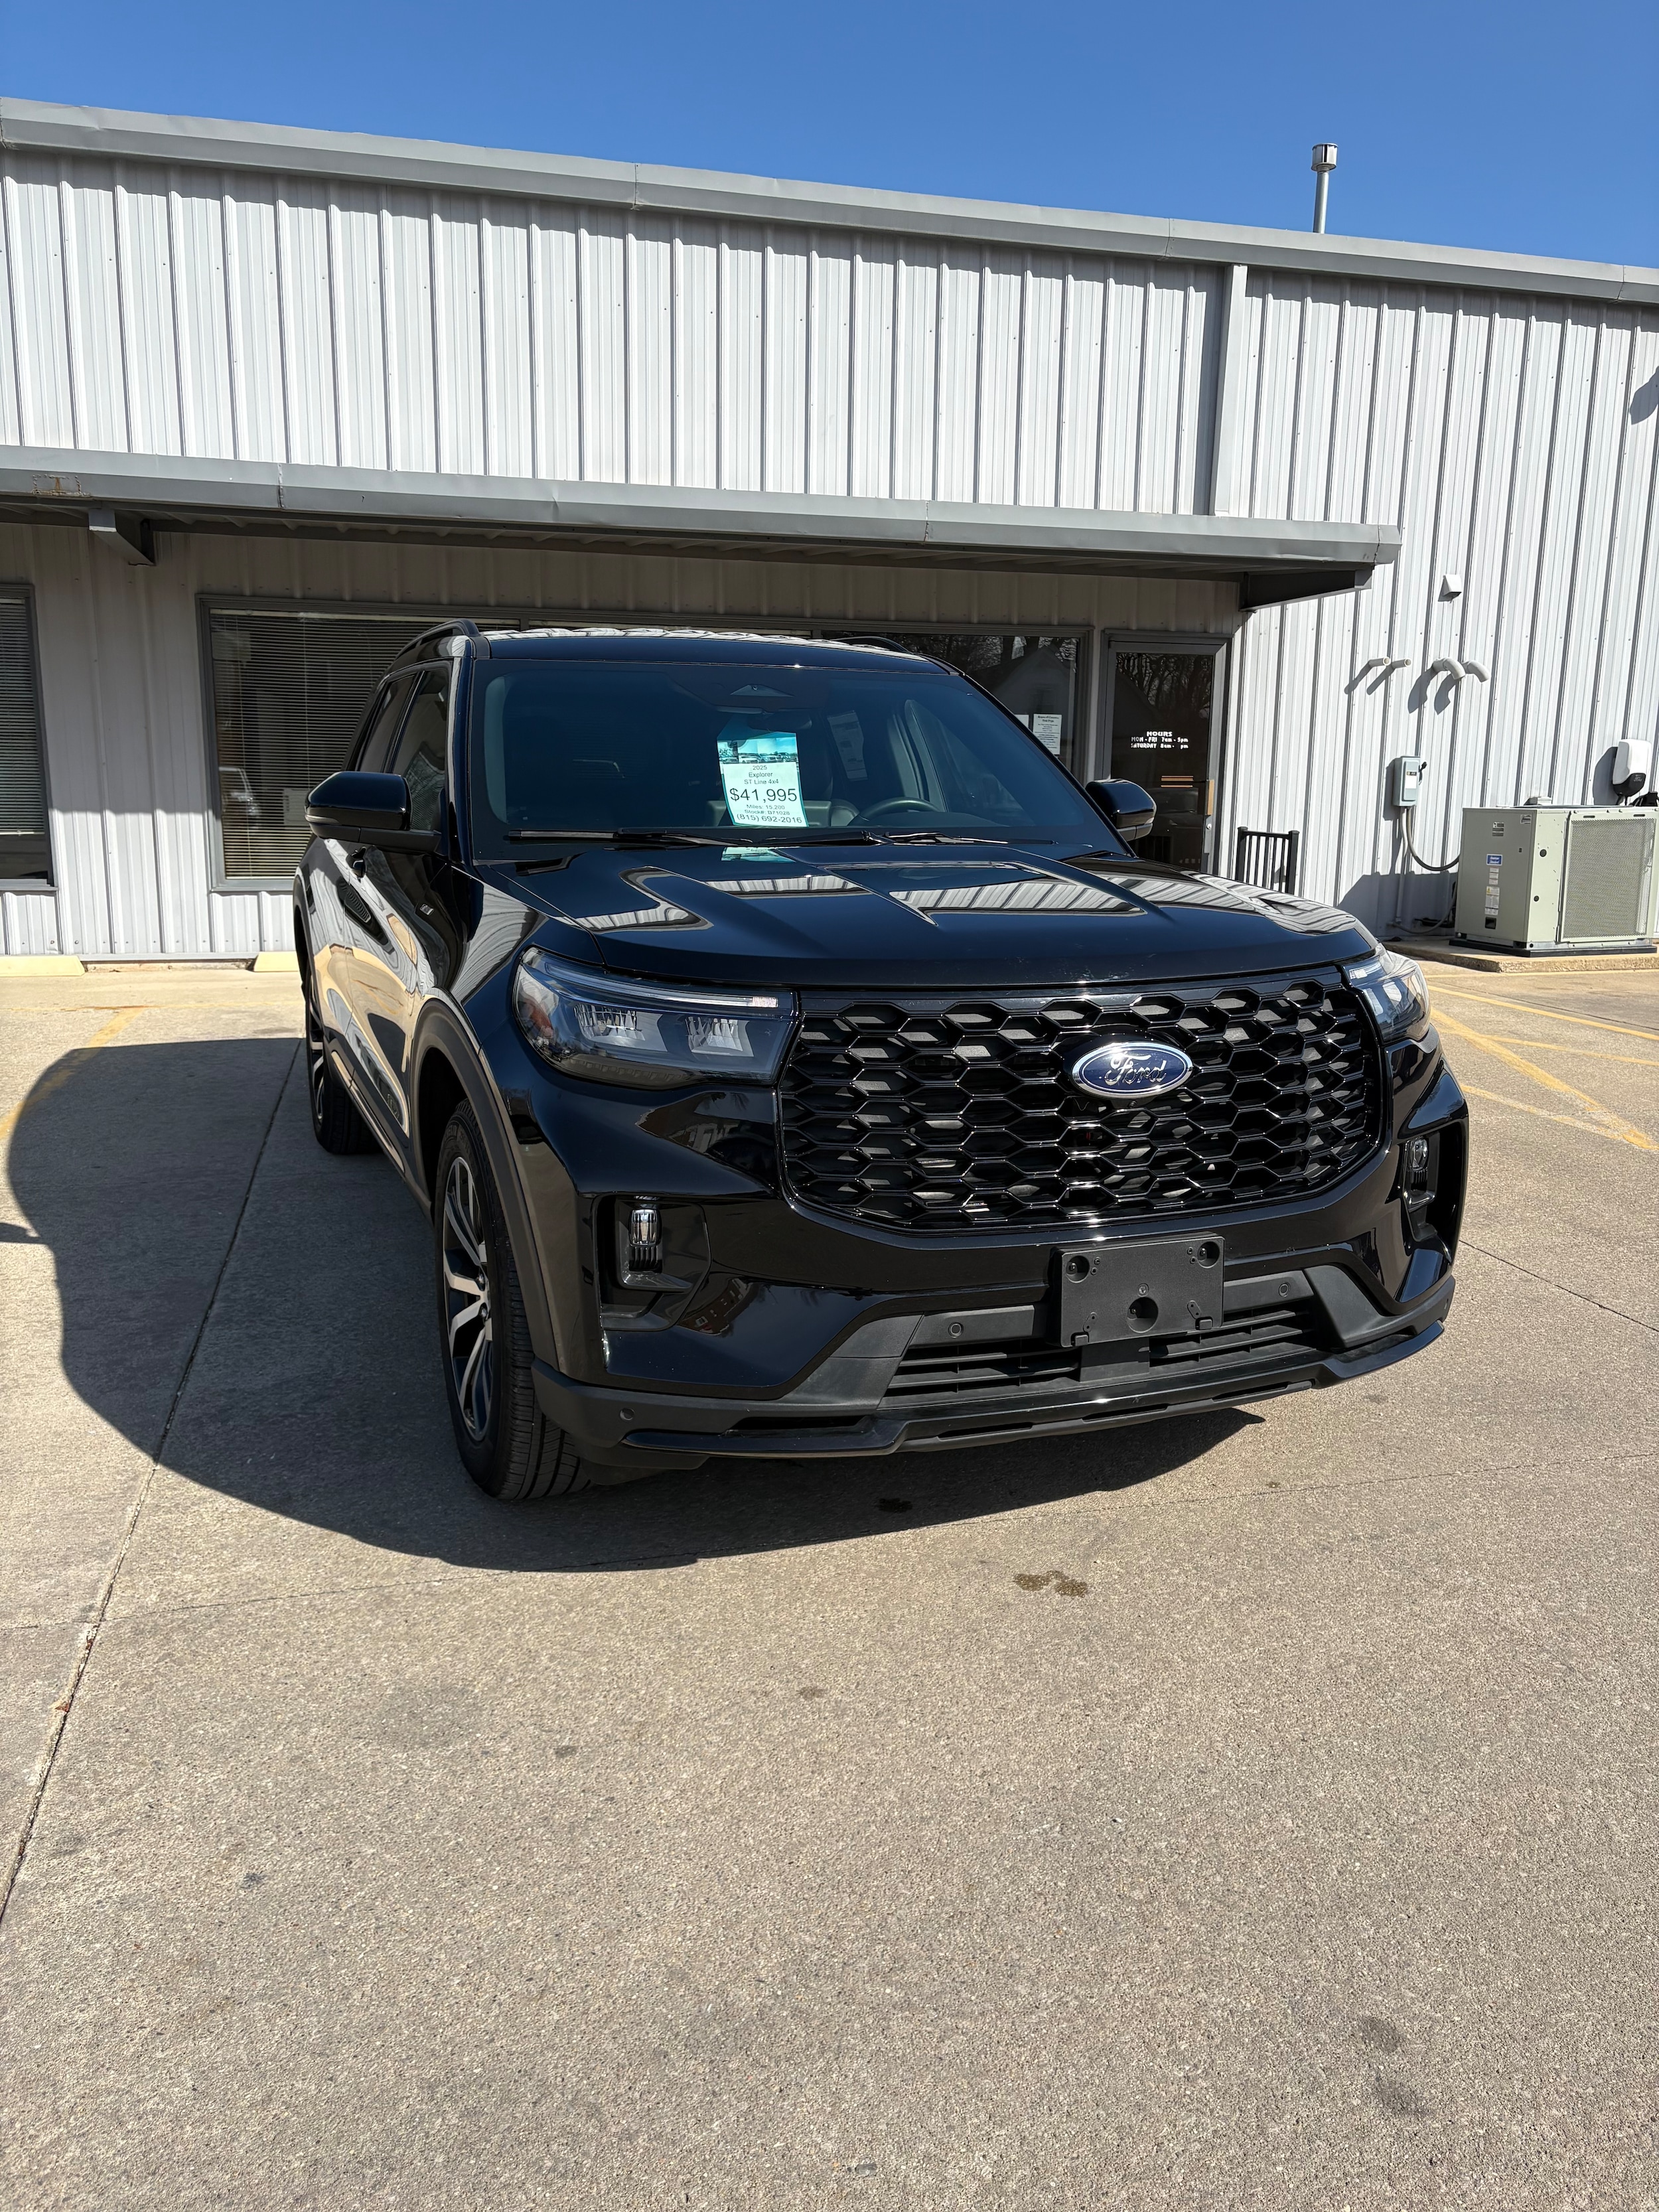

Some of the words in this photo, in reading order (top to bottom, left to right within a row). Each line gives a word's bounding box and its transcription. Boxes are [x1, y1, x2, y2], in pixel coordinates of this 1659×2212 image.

[729, 788, 797, 803] $41,995
[737, 814, 759, 822] (815)
[1104, 1051, 1167, 1086] Ford
